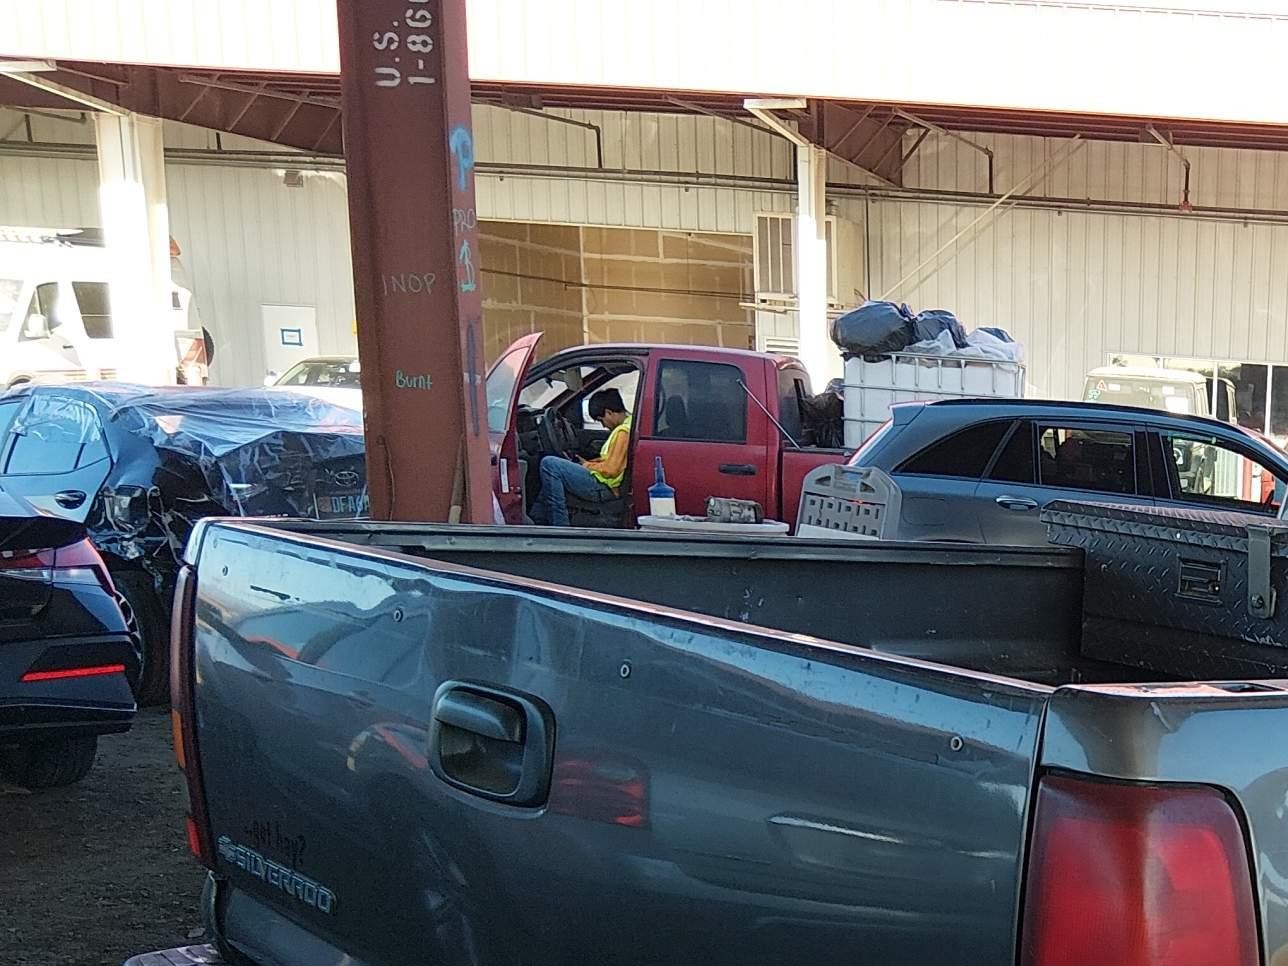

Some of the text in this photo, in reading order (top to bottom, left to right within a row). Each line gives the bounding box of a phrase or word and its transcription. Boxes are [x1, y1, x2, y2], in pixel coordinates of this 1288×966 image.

[373, 21, 401, 87] U.S.
[406, 0, 436, 84] 1-86
[382, 272, 436, 296] INOP
[395, 369, 433, 390] Burnt
[236, 844, 337, 914] SILVERADO
